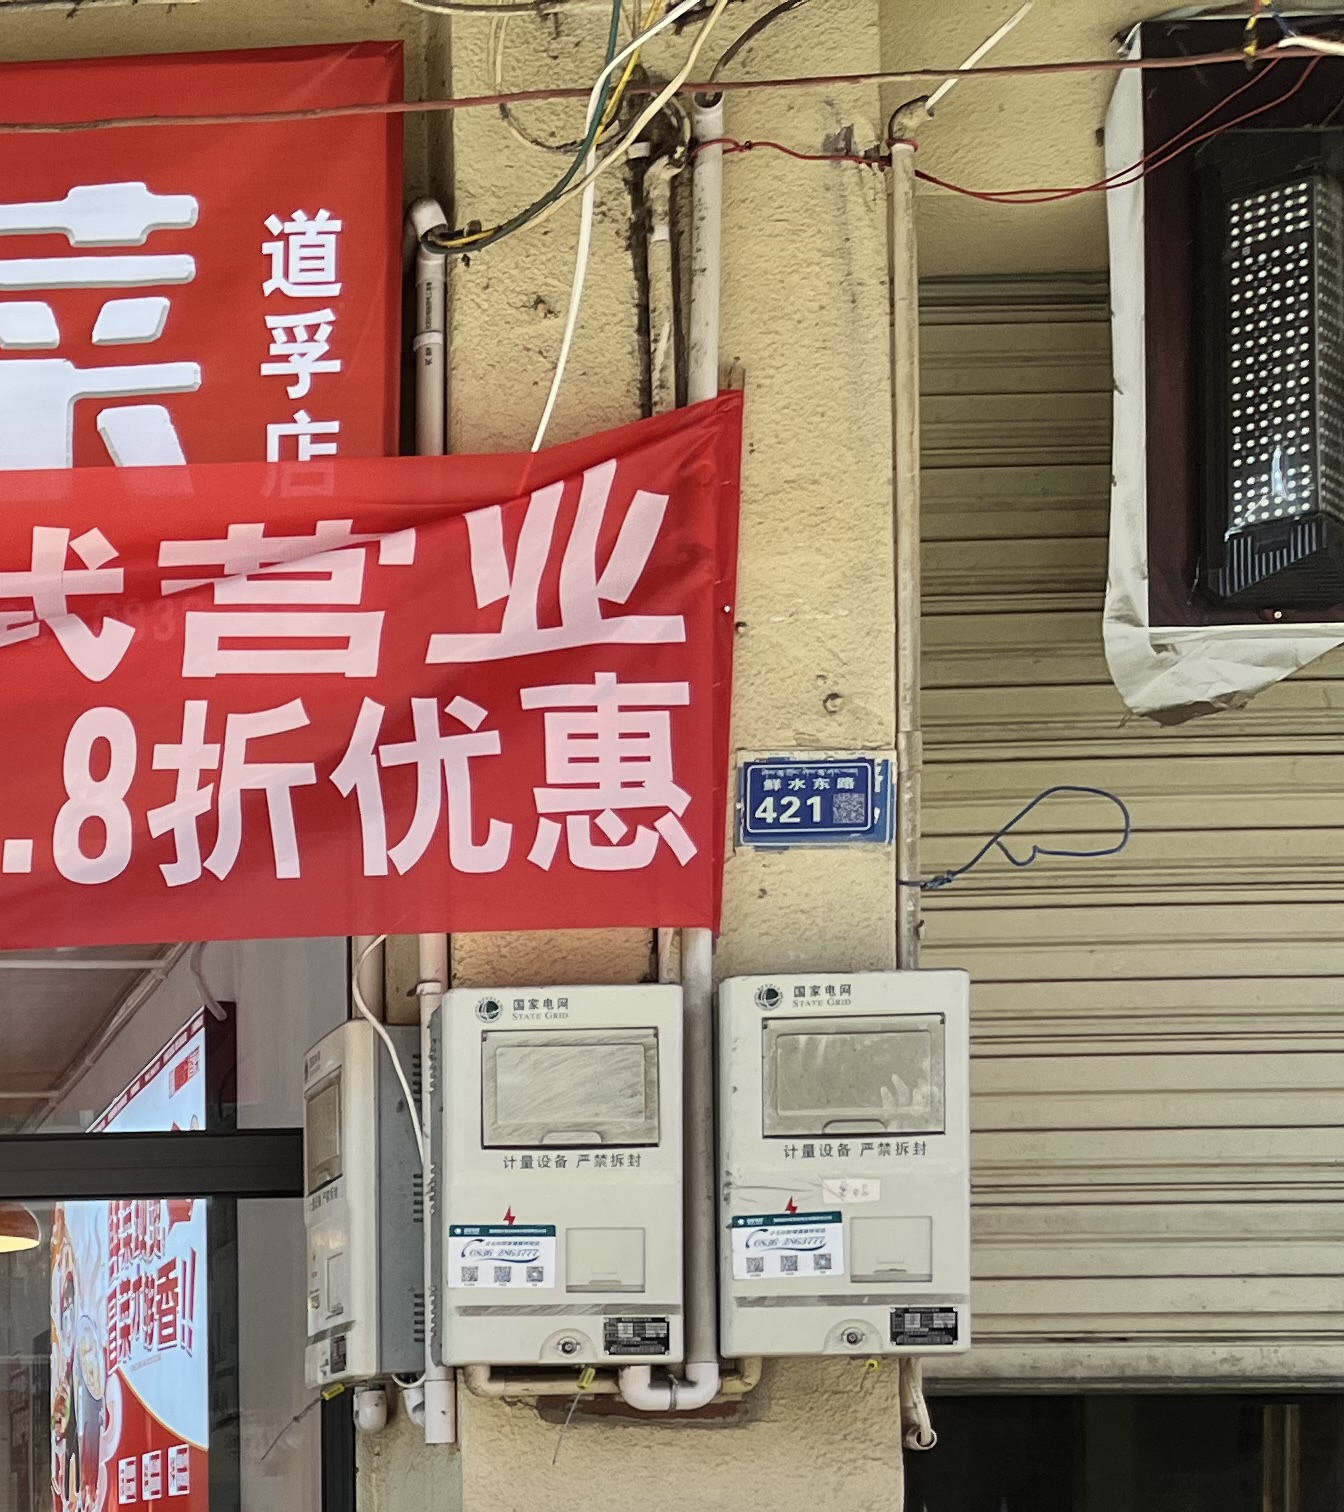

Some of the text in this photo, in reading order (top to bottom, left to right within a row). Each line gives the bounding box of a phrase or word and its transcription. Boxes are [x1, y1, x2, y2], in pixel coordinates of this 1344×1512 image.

[260, 207, 342, 497] 道孚店
[764, 777, 855, 791] 鲜水东路
[755, 796, 822, 824] 421
[794, 984, 852, 997] 国家电网
[513, 998, 569, 1011] 国家电网
[784, 1141, 927, 1159] 计量设备 严禁拆封
[503, 1153, 641, 1170] 计量设备 严禁拆封
